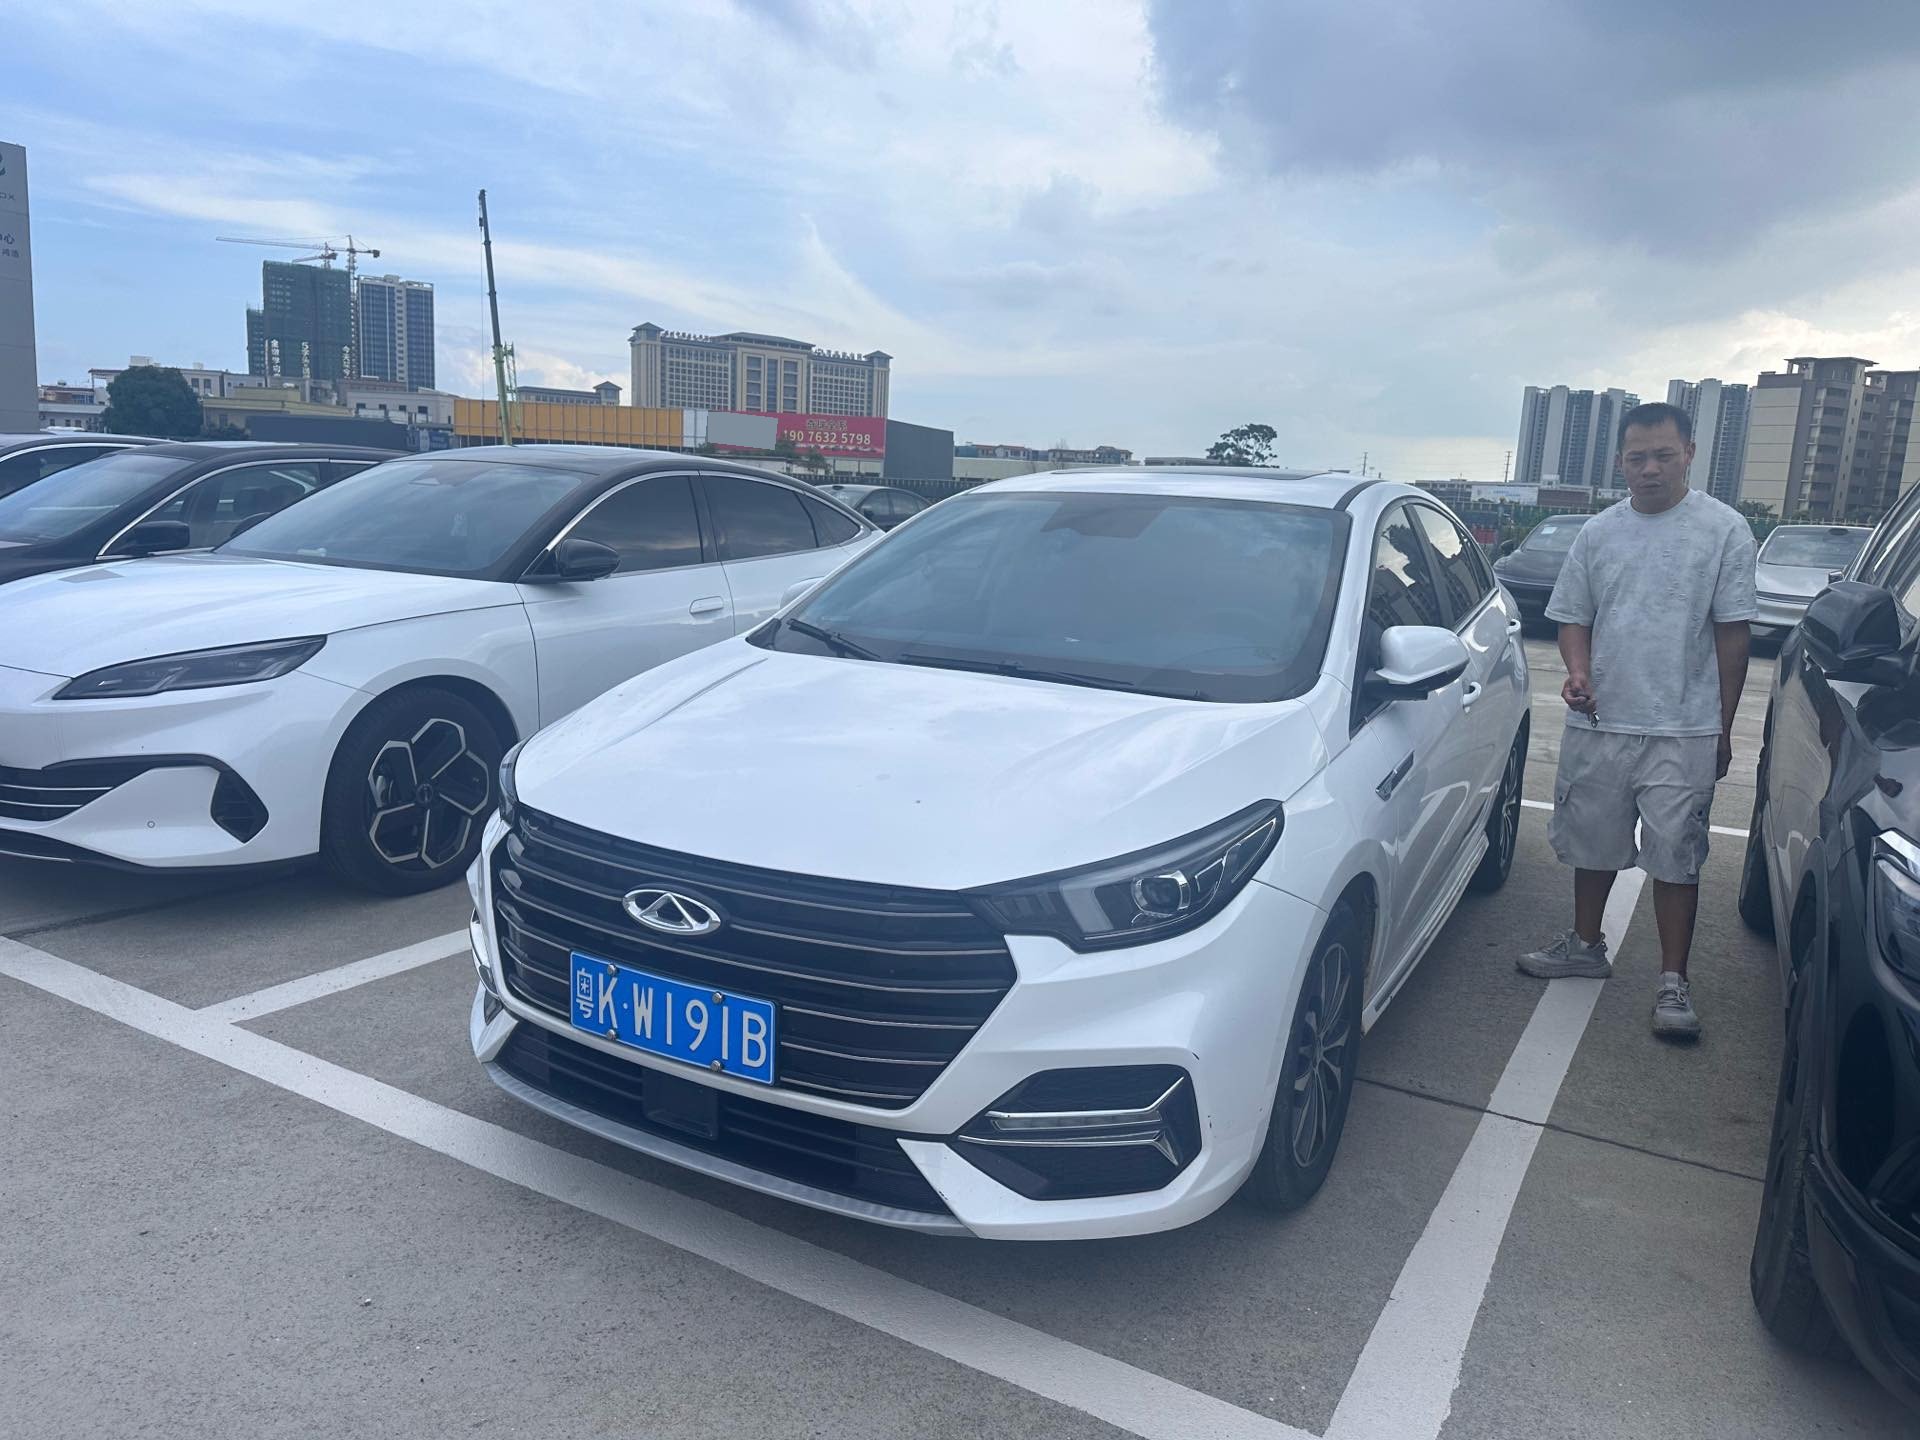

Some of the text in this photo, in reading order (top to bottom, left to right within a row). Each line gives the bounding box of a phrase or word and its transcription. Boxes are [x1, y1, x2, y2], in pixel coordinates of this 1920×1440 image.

[808, 431, 837, 443] 7632
[841, 433, 871, 445] 5798
[575, 967, 767, 1068] 粤K·W191B
